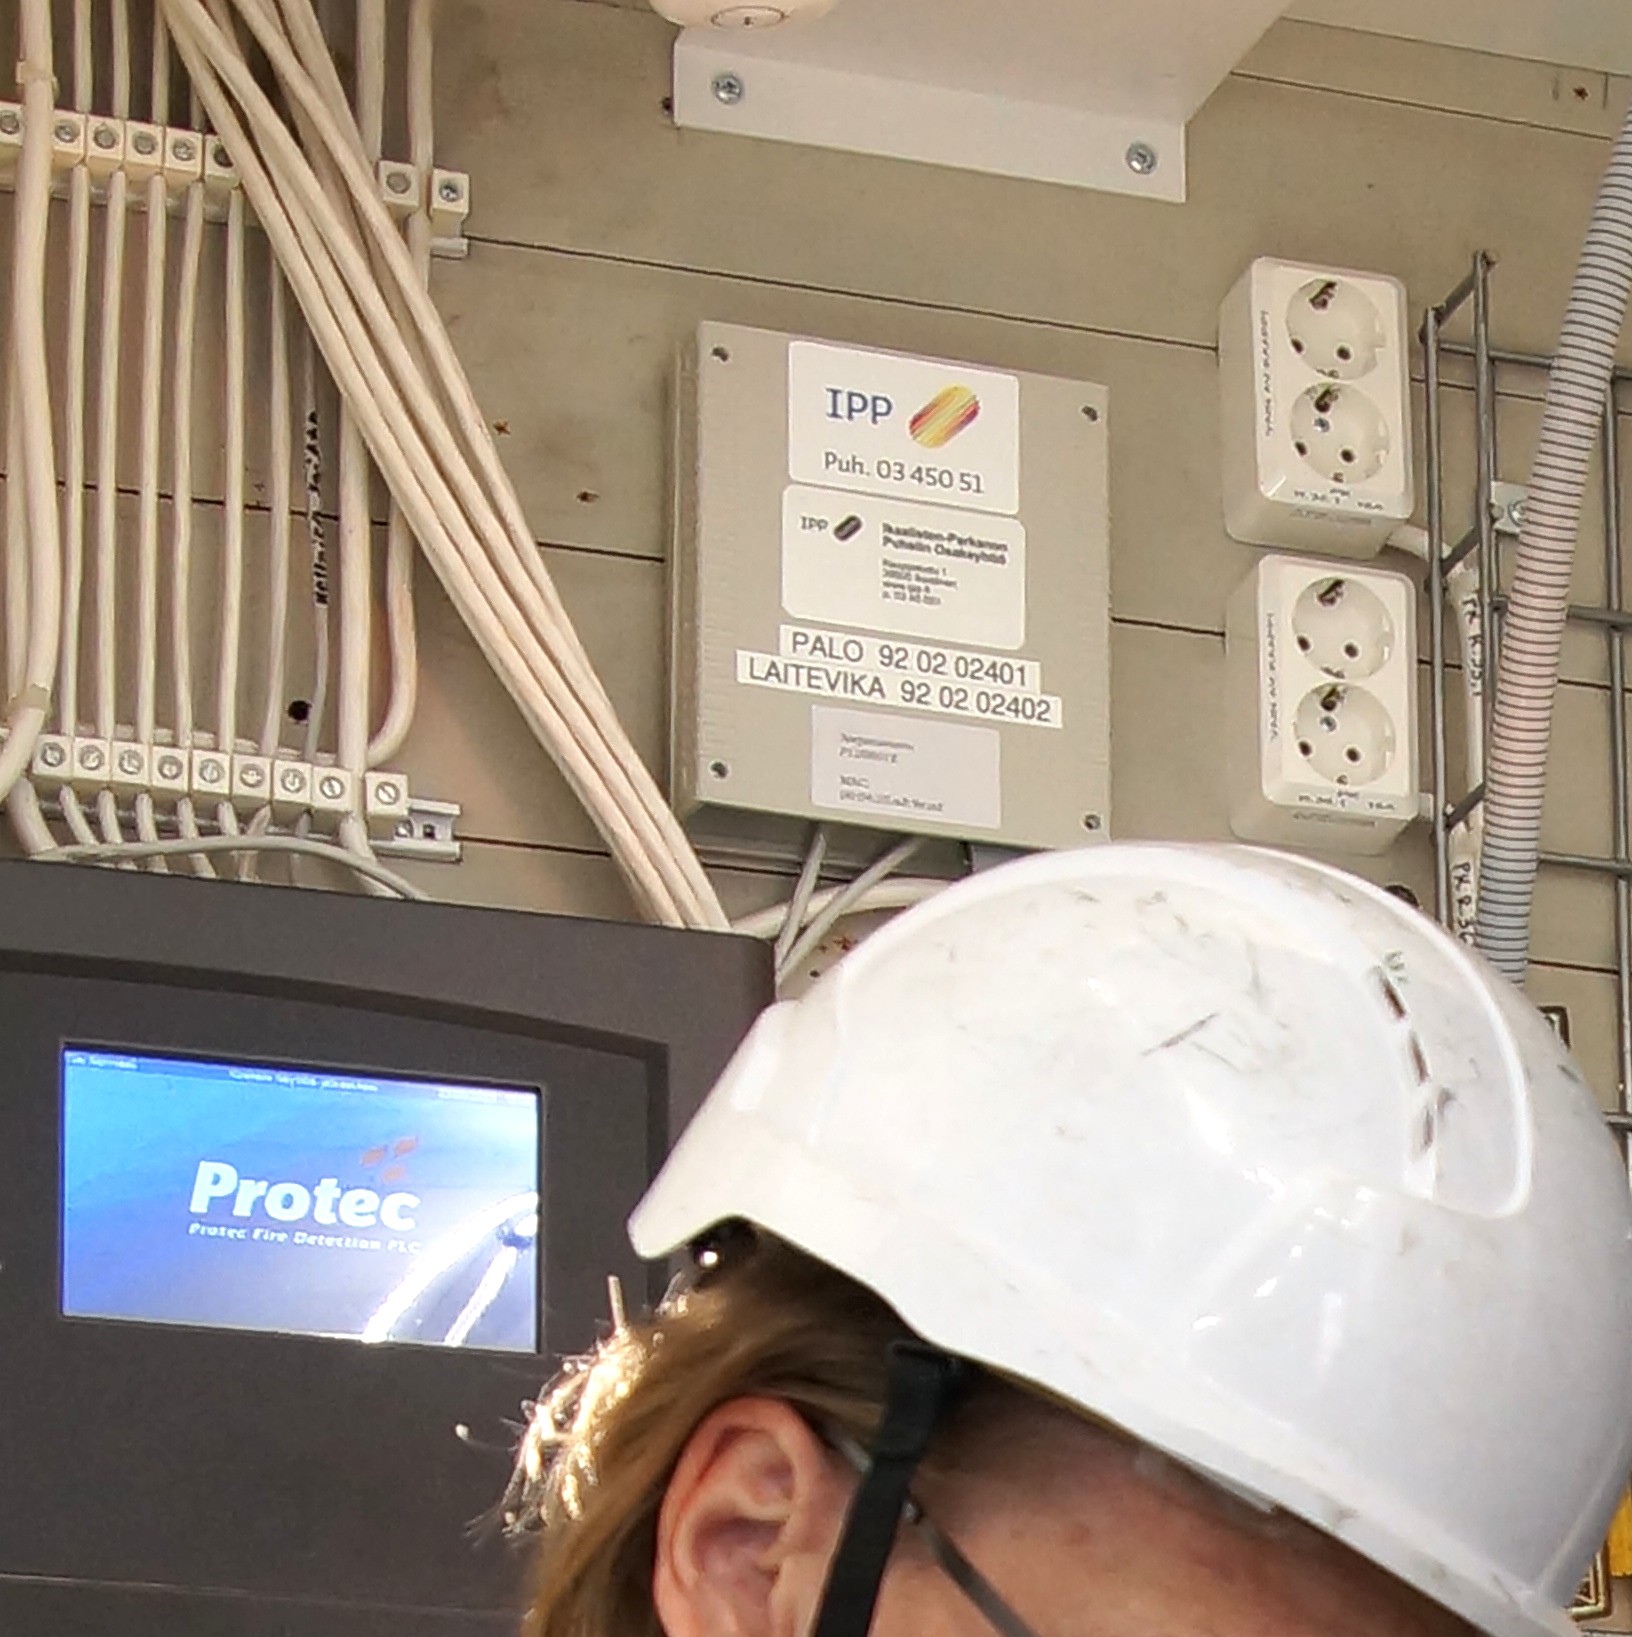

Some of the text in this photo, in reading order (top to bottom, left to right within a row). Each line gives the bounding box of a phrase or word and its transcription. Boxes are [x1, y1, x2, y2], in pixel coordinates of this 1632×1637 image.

[826, 388, 893, 424] IPP
[825, 451, 985, 493] Puh. 03 450 51
[792, 631, 1026, 686] PALO 92 02 02401
[750, 657, 1050, 722] LAITEVIKA 92 02 02402
[189, 1160, 421, 1232] Protec
